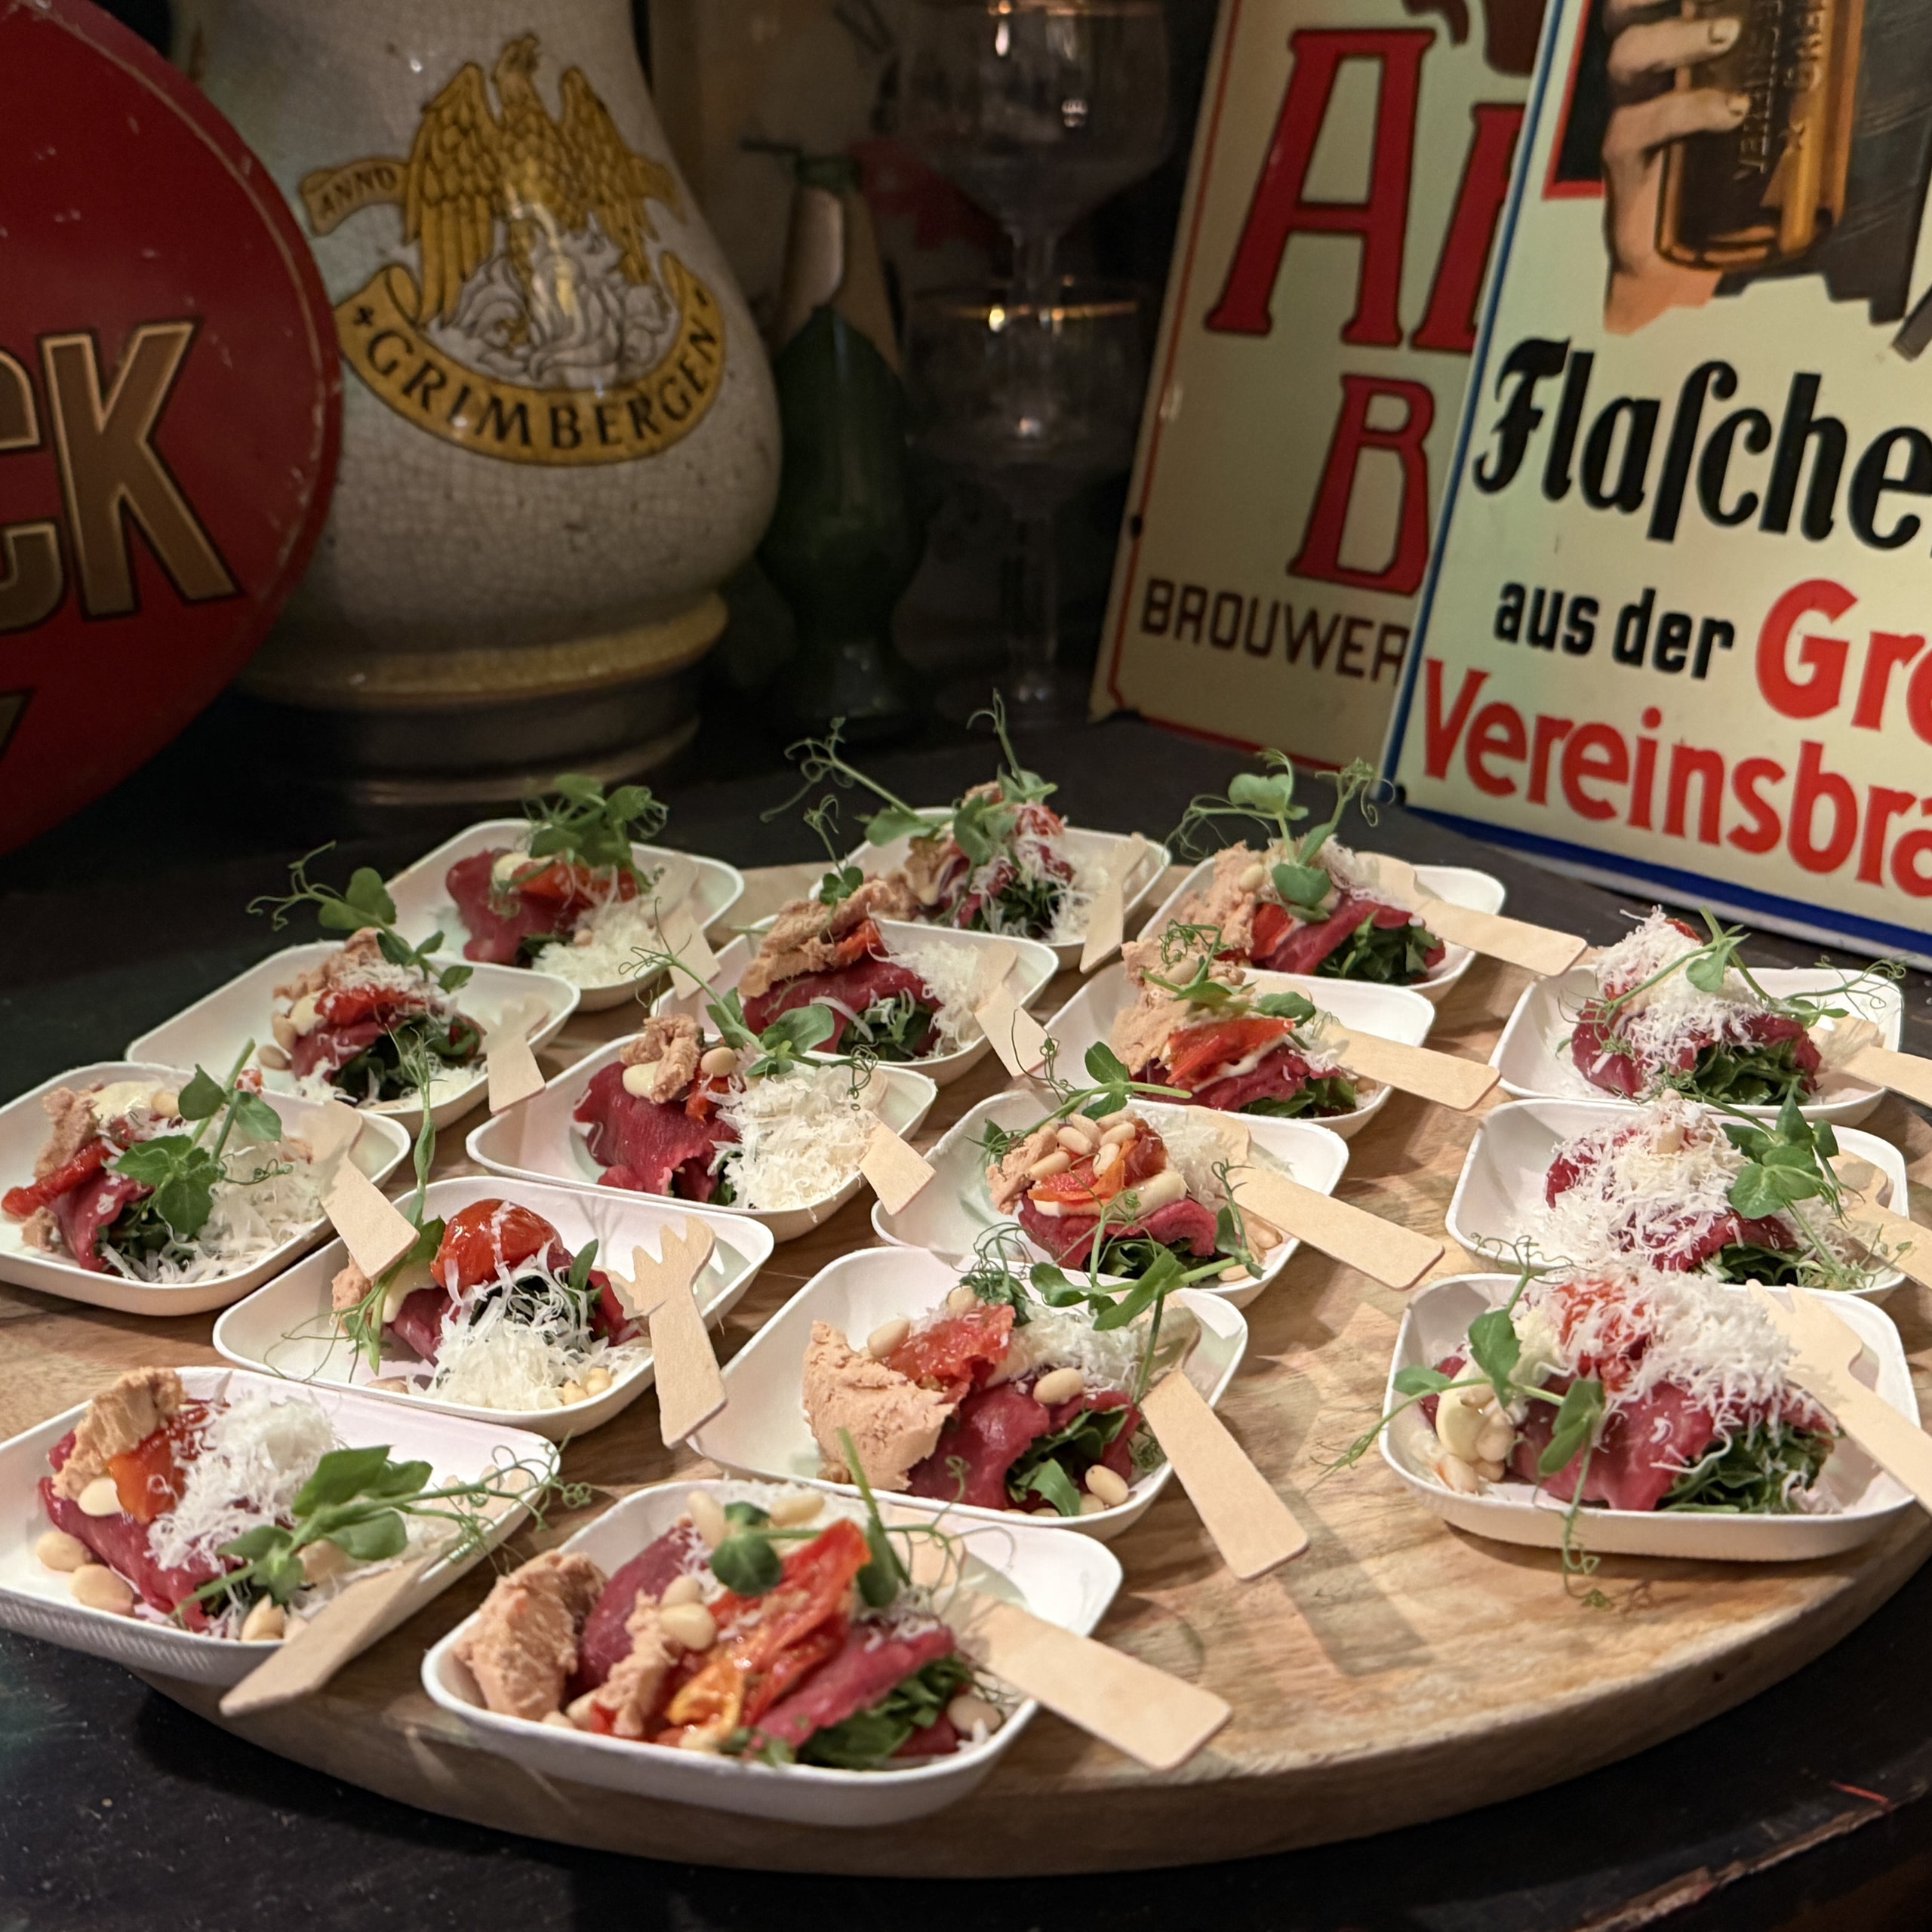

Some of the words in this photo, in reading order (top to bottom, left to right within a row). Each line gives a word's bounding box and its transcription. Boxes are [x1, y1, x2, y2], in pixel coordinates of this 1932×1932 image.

[318, 165, 398, 220] ANNO
[365, 317, 720, 451] GRIMBERGEN
[1140, 577, 1411, 685] BROUWER
[1493, 580, 1600, 657] aus
[1612, 587, 1736, 680] der
